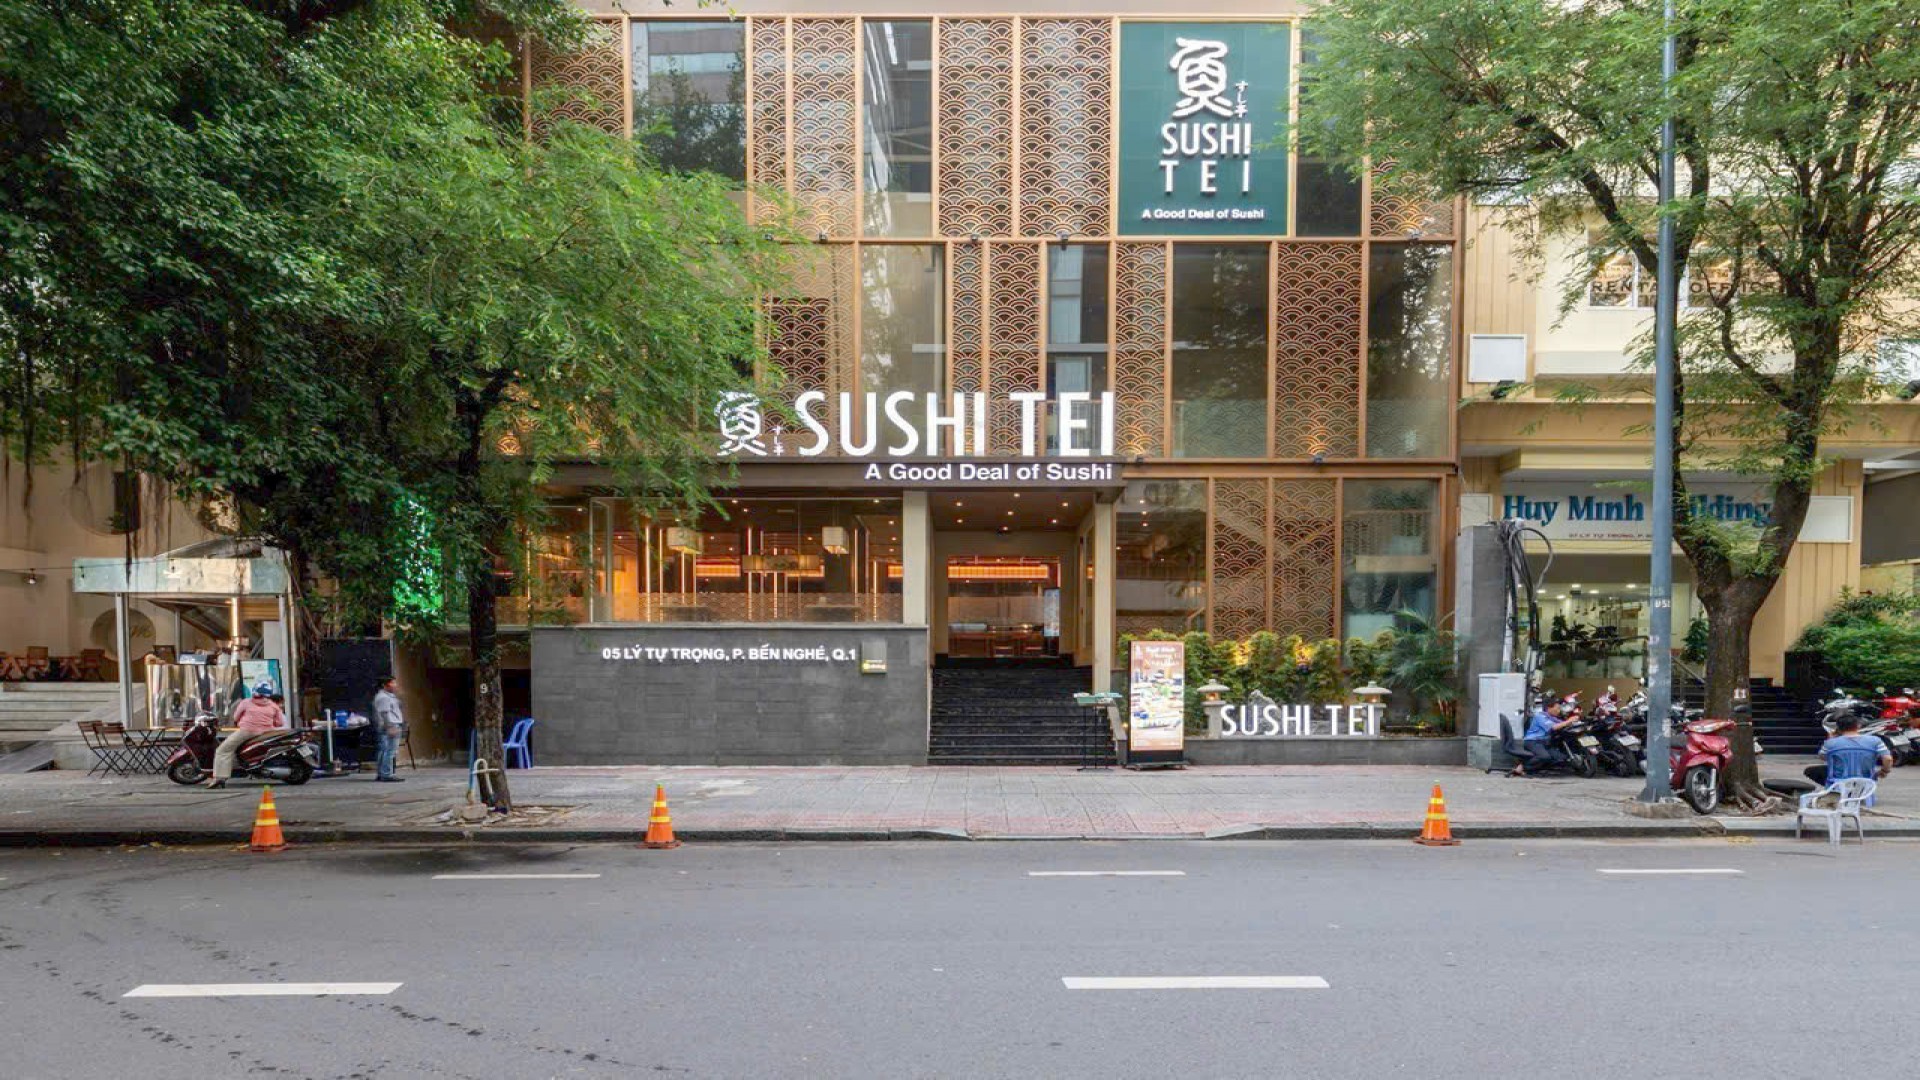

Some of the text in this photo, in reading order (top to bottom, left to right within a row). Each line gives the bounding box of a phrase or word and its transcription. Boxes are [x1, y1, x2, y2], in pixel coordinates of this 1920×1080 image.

[1161, 122, 1251, 155] SUSHI
[1142, 208, 1264, 219] A Good Deal of Sushi
[794, 390, 985, 457] SUSHI
[1008, 391, 1114, 457] TEI
[865, 463, 1113, 481] A Good Deal of Sushi
[1503, 494, 1560, 527] Huy
[1568, 493, 1645, 521] Minh
[602, 647, 621, 660] 05
[732, 648, 745, 660] P.
[833, 648, 856, 660] Q.1
[1220, 703, 1375, 736] SUSHI TEI
